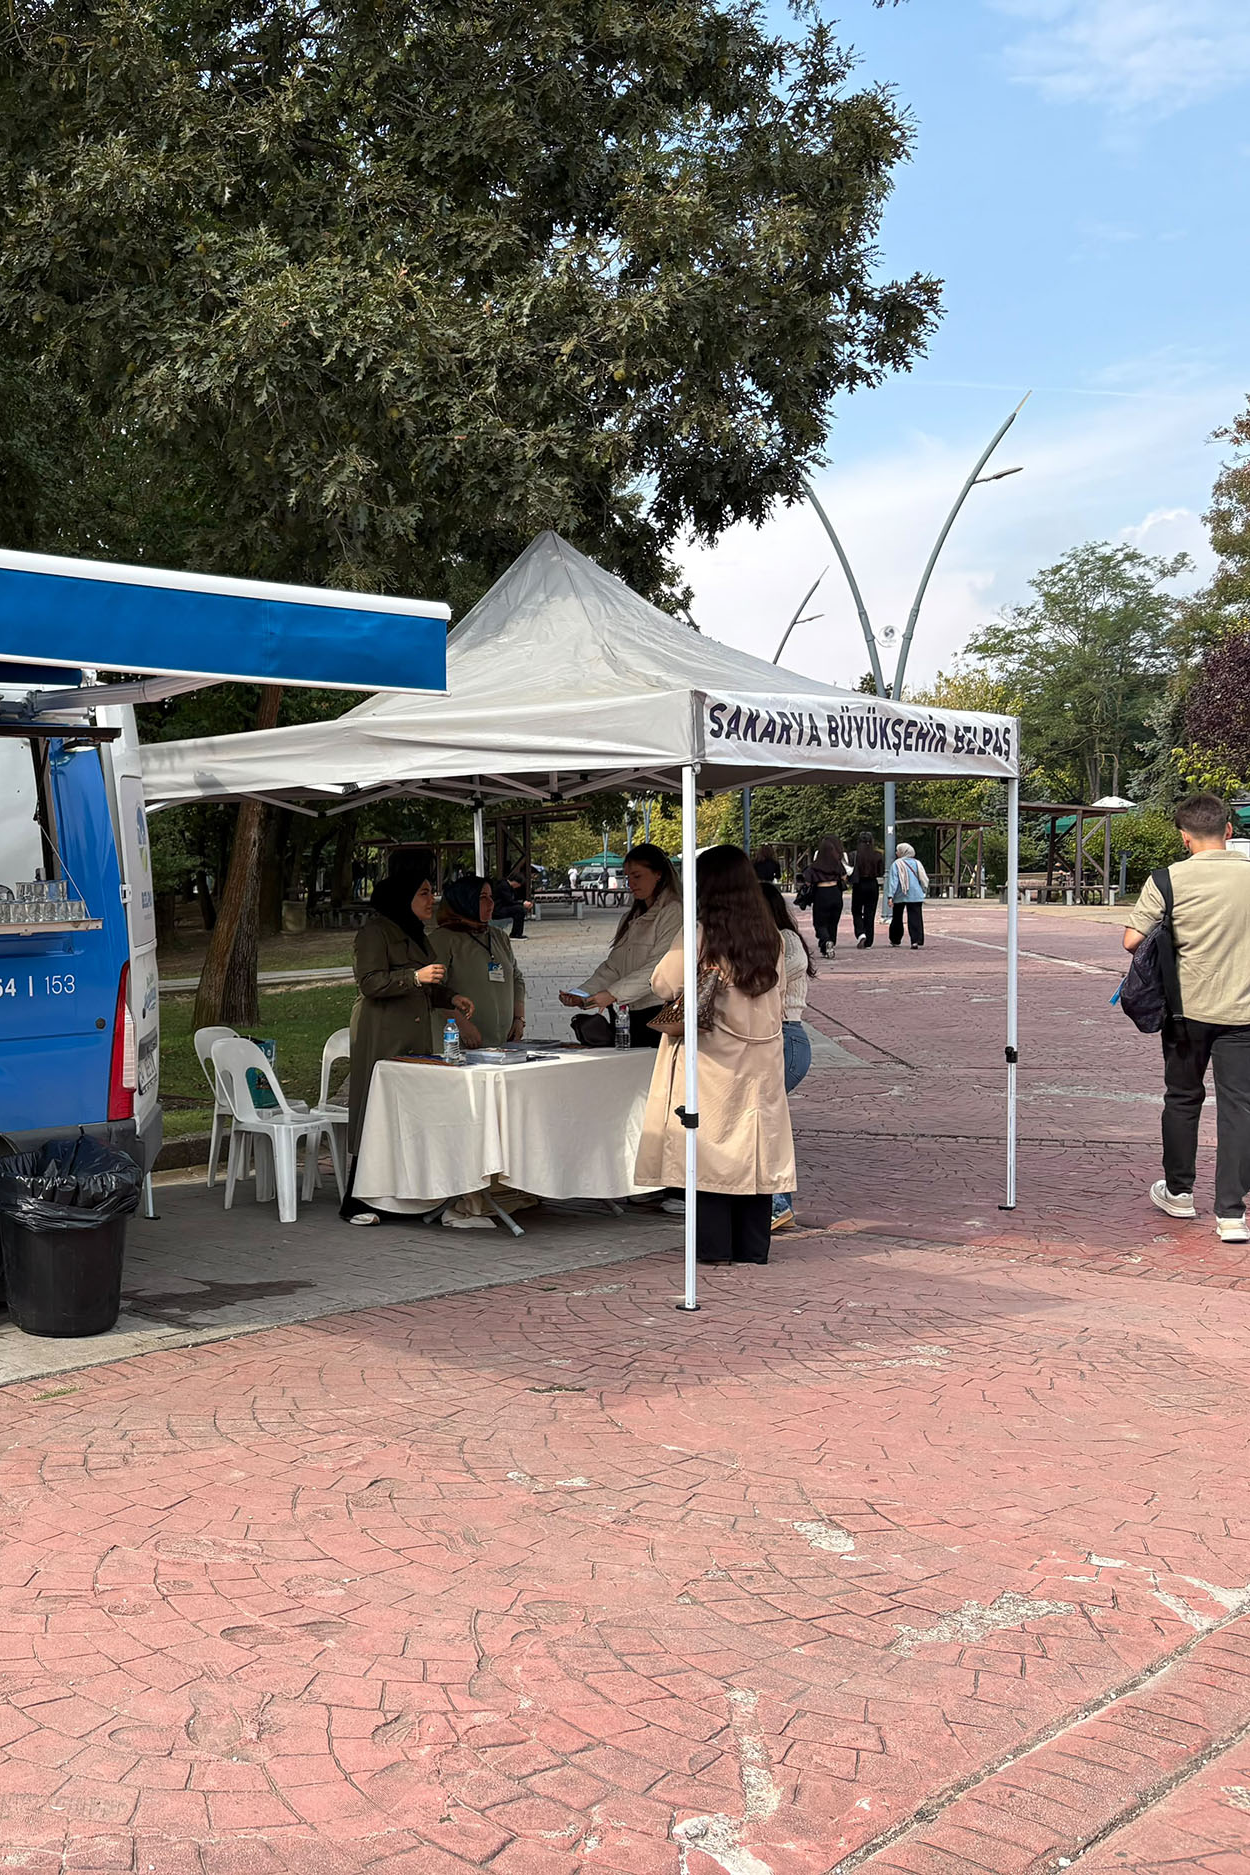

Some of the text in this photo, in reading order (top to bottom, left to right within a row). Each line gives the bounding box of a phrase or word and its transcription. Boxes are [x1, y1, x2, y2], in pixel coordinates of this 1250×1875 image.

[709, 702, 1011, 762] SAKARYA BÜYÜKŞEHİR BELPAŞ
[45, 973, 76, 995] 153
